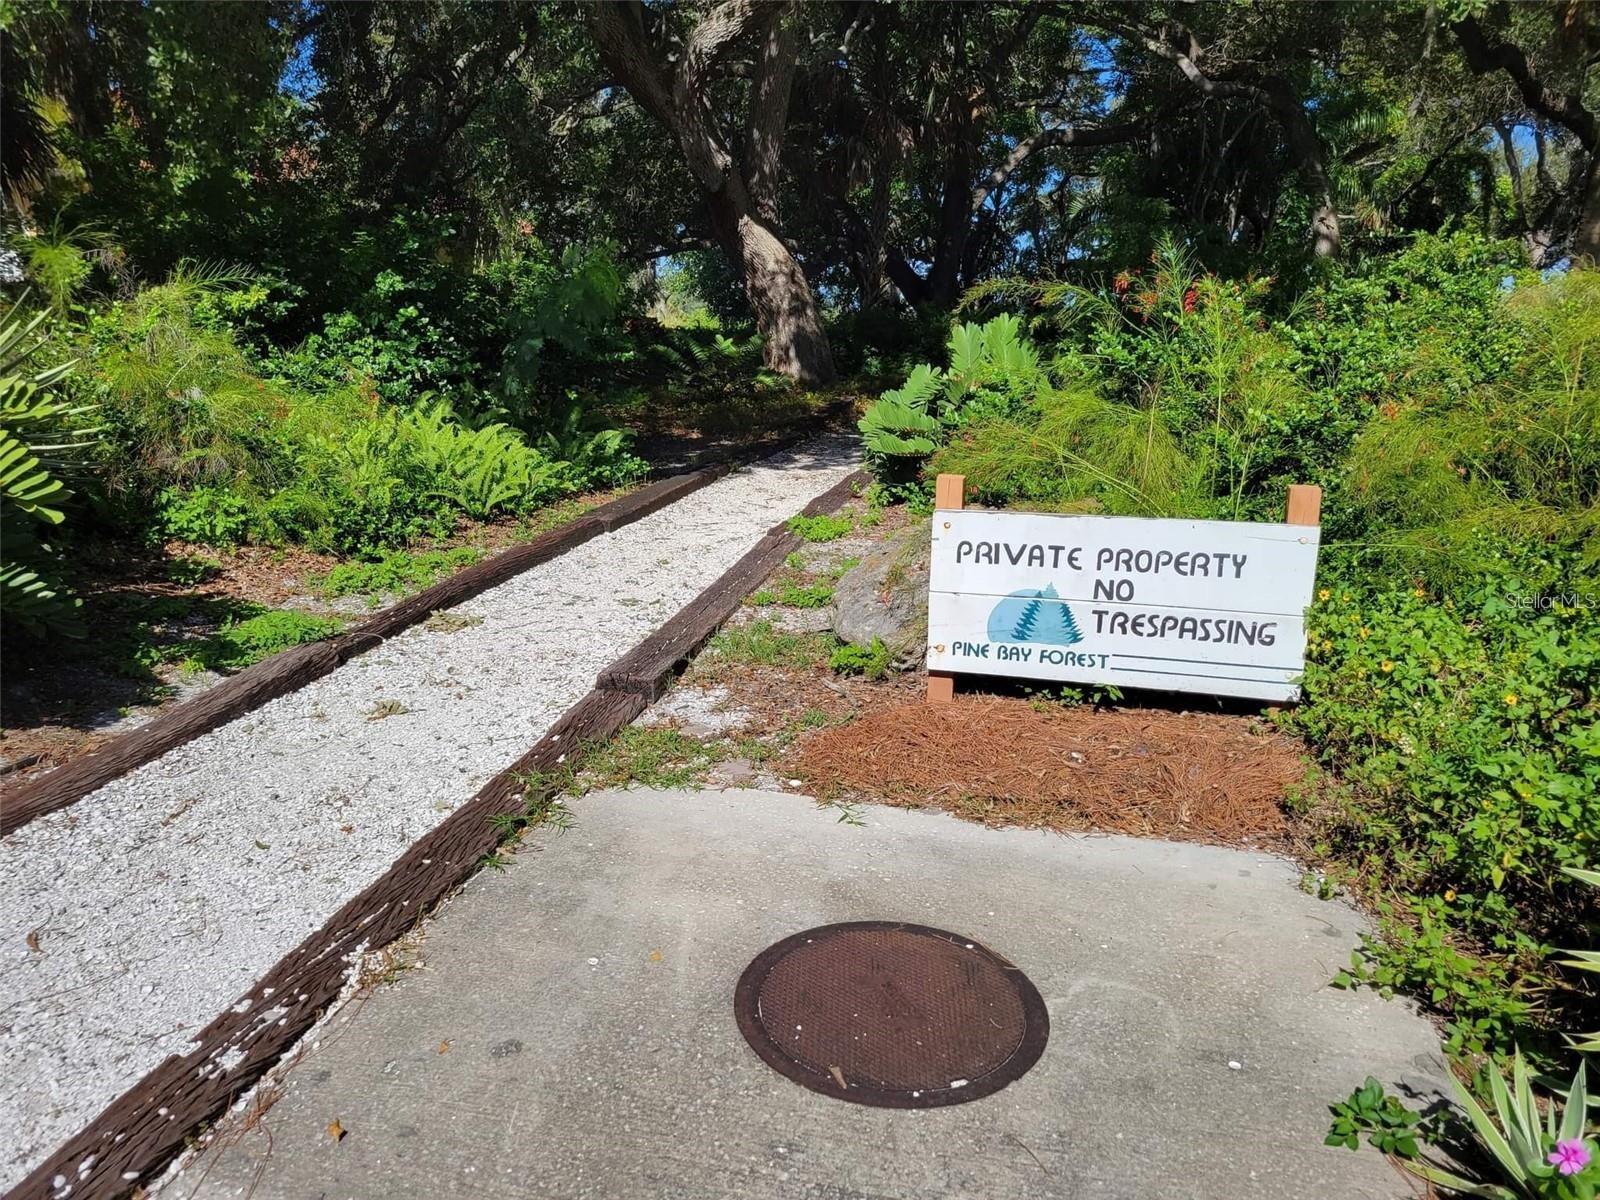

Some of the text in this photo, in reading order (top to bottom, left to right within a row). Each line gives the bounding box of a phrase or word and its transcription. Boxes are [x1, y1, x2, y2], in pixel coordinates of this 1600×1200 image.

[956, 540, 1247, 579] PRIVATE PROPERTY
[1093, 578, 1134, 602] NO
[1092, 609, 1277, 647] TRESPASSING
[952, 641, 1110, 669] PINE BAY FOREST
